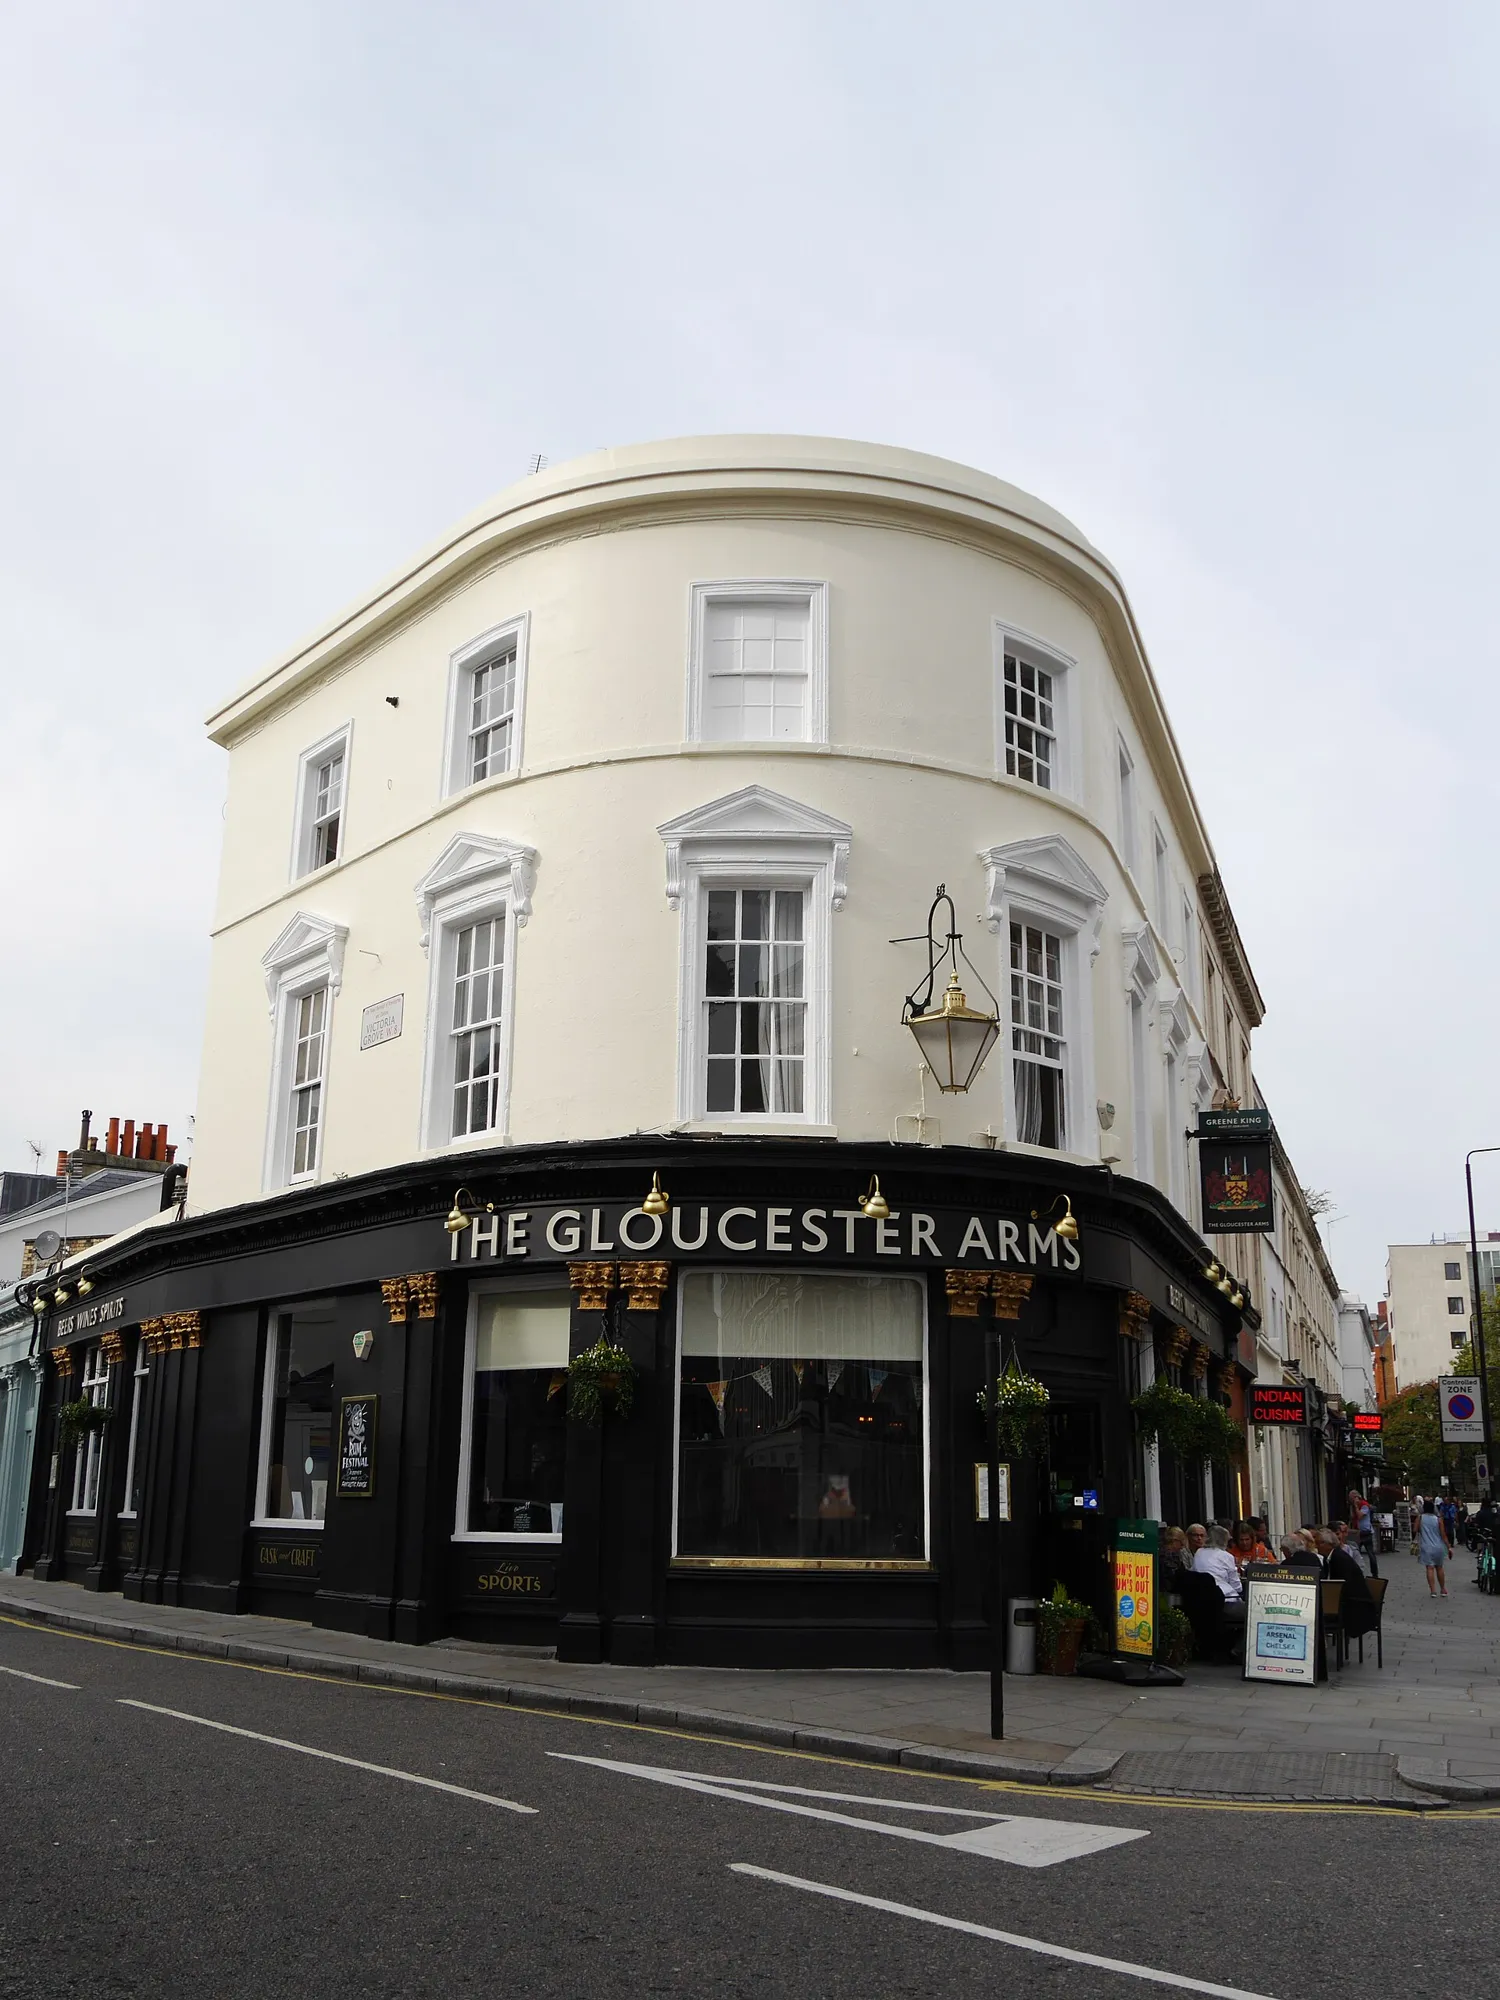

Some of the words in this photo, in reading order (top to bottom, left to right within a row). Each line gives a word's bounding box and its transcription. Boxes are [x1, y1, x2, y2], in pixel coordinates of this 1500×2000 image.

[366, 1016, 396, 1034] VICTORIA
[362, 1029, 384, 1046] GROVE
[1205, 1117, 1239, 1126] GREENE
[1240, 1116, 1262, 1125] KING
[1219, 1220, 1253, 1228] GLOUCESTER
[444, 1212, 528, 1261] THE
[546, 1206, 943, 1257] GLOUCESTER
[957, 1216, 1081, 1271] ARMS
[1254, 1389, 1302, 1403] INDIAN
[1447, 1386, 1473, 1394] ZONE
[1253, 1407, 1303, 1421] CUISINE
[1354, 1415, 1381, 1424] INDIAN
[342, 1456, 369, 1469] FESTIVAL
[260, 1547, 278, 1565] CASK
[291, 1548, 316, 1567] CRAFT
[495, 1562, 520, 1575] Live
[1135, 1565, 1150, 1580] OUT
[1251, 1571, 1295, 1581] GLOUCESTER
[1295, 1574, 1315, 1582] ARMS
[1135, 1580, 1150, 1595] OUT
[1253, 1592, 1299, 1606] WATCH
[1300, 1597, 1314, 1609] IT
[1266, 1631, 1297, 1640] ARSENAL
[1266, 1642, 1296, 1651] CHELSEA
